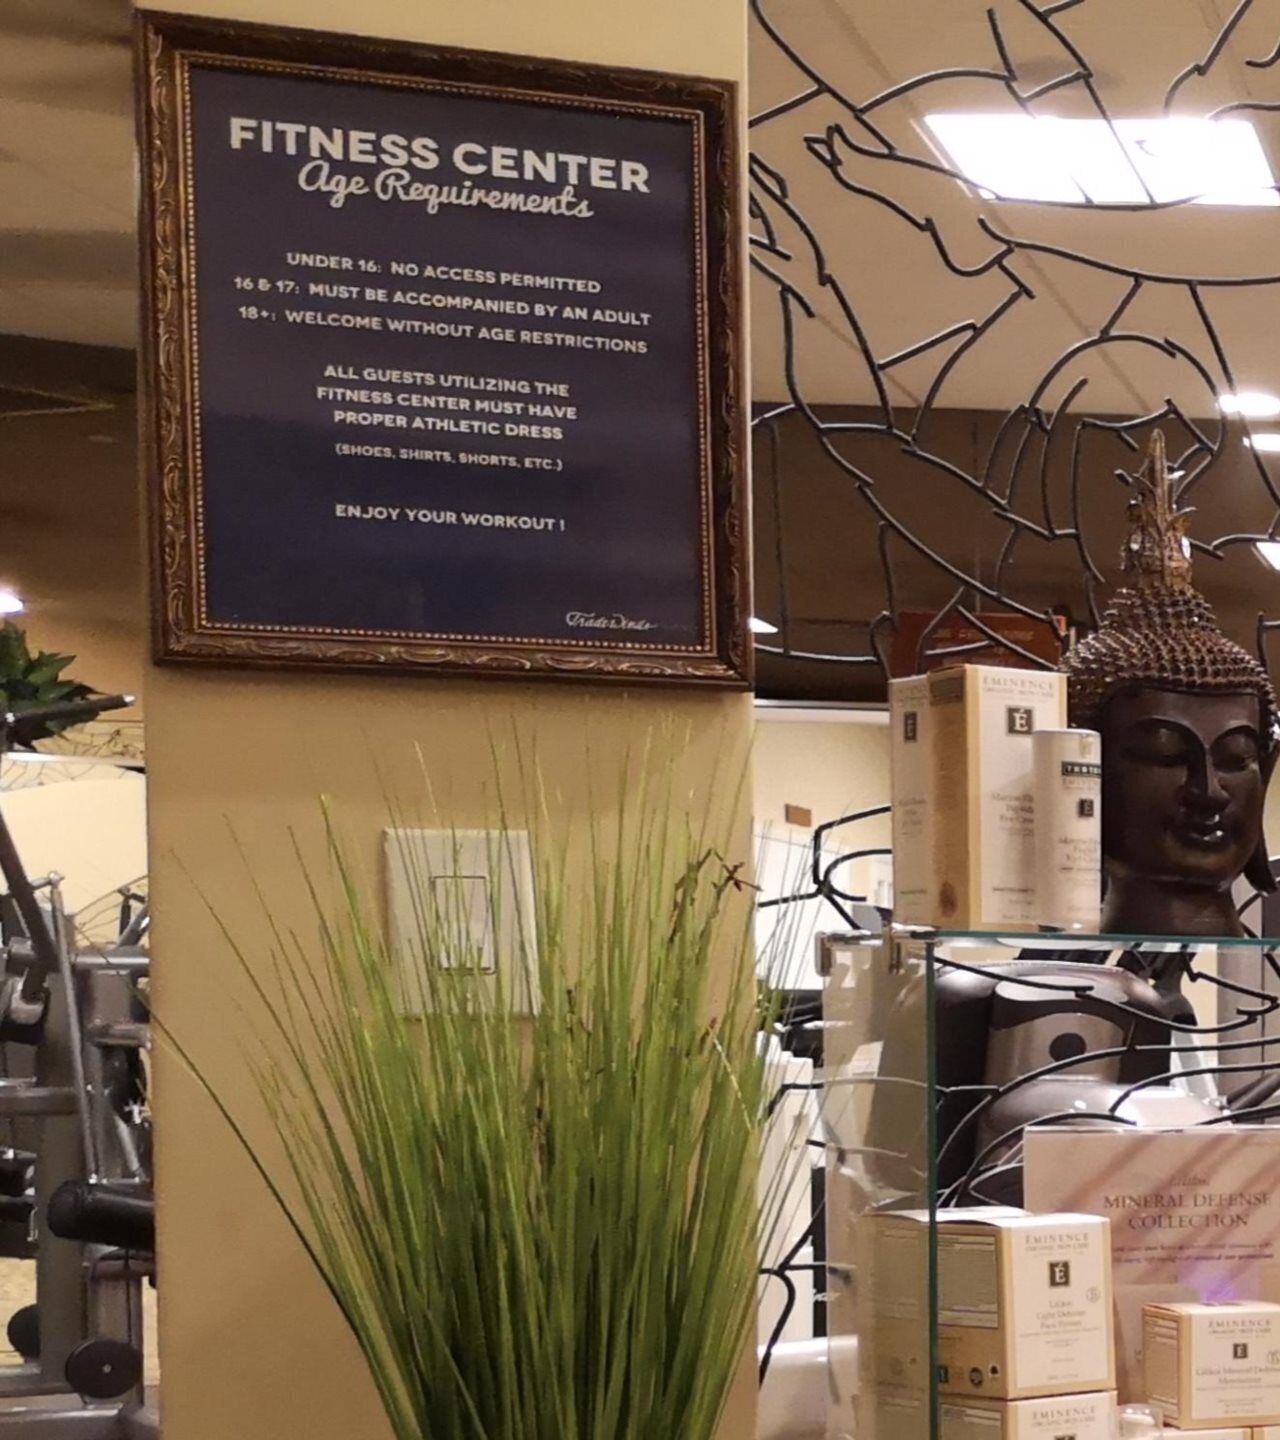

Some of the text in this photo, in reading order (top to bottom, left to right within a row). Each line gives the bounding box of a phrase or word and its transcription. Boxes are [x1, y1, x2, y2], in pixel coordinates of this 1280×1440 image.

[230, 117, 650, 193] FITNESS CENTER
[298, 160, 594, 217] Age Requirements
[286, 252, 602, 293] UNDER 16: NO ACCESS PERMITTED
[234, 276, 652, 326] 16 & 17: MUST BE ACCOMPANIED BY AN ADULT
[285, 309, 383, 330] WELCOME
[386, 318, 474, 338] WITHOUT
[478, 327, 516, 342] AGE
[520, 329, 649, 354] RESTRICTIONS
[324, 365, 569, 398] ALL GUESTS UTILIZING THE
[316, 385, 577, 420] FITNESS CENTER MUST HAVE
[333, 410, 563, 440] PROPER ATHLETIC DRESS
[335, 443, 563, 472] (SHOES, SHIRTS, SHORTS, ETC.)
[335, 504, 401, 521] ENJOY
[405, 508, 458, 525] YOUR
[461, 512, 556, 530] WORKOUT
[1104, 1192, 1271, 1209] MINERAL DEFENSE
[1128, 1214, 1248, 1230] COLLECTION
